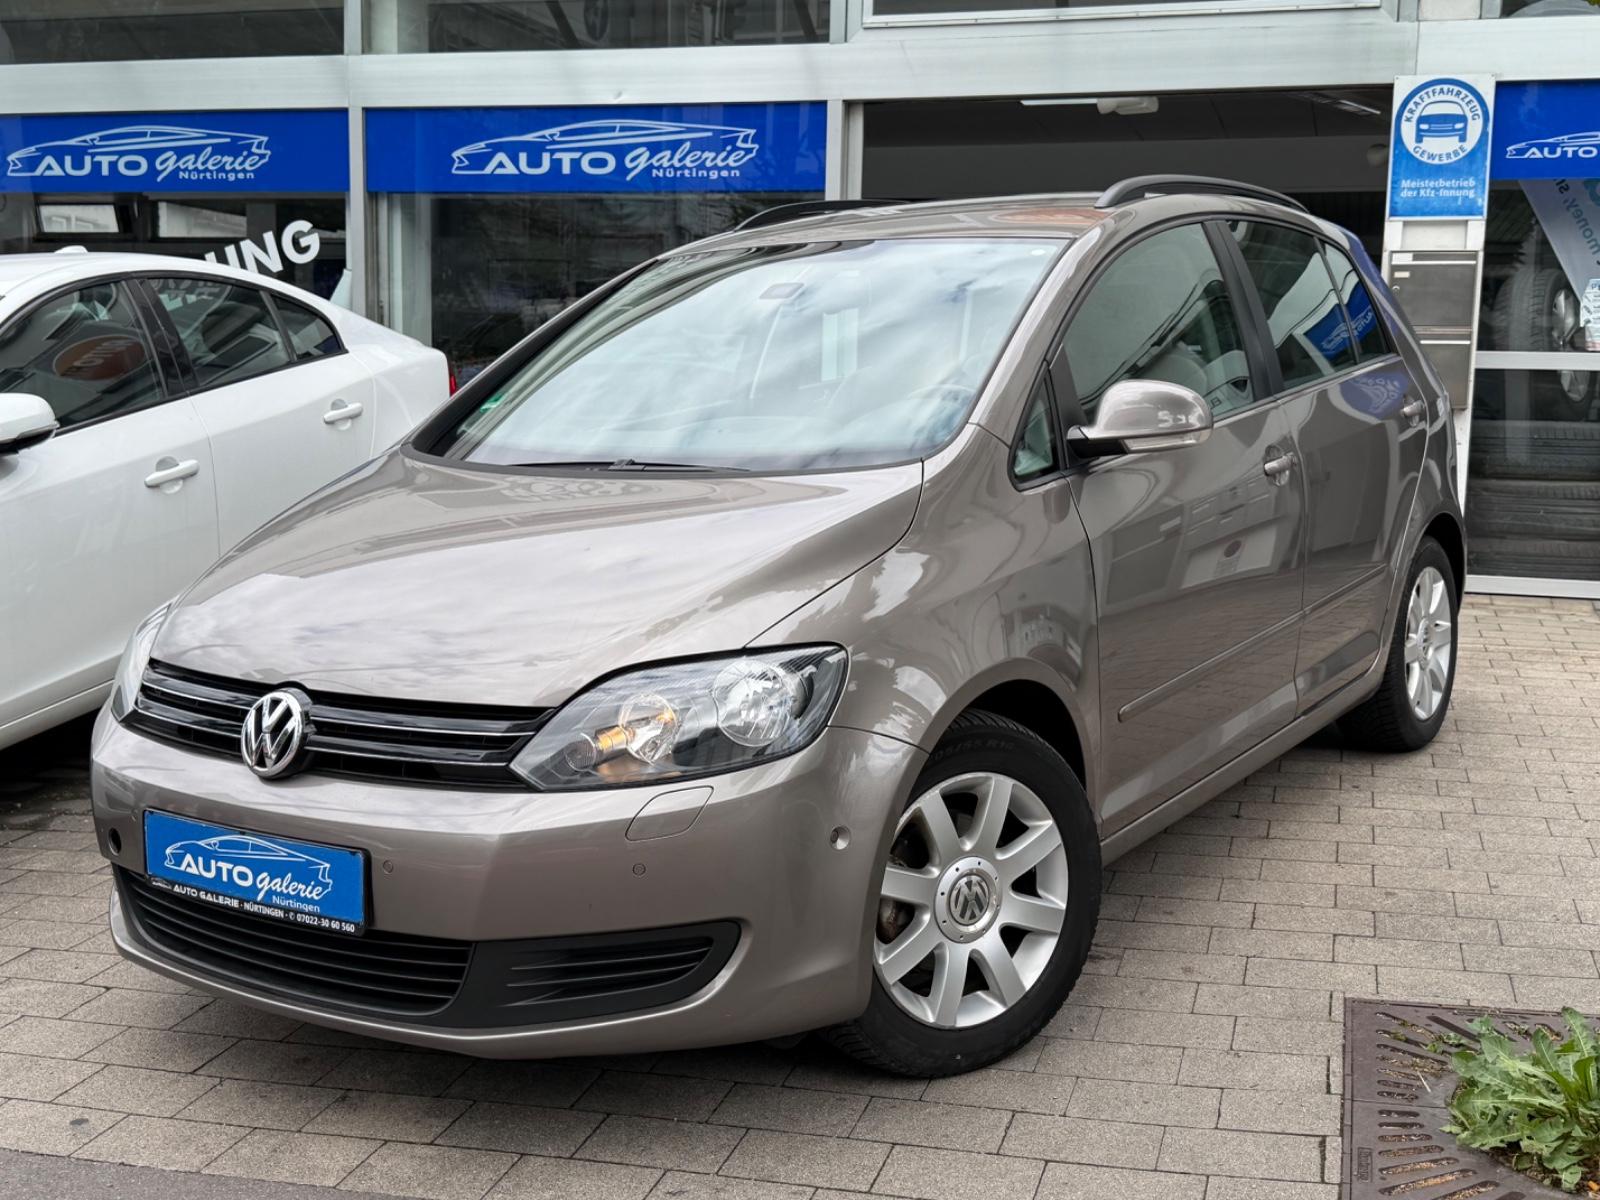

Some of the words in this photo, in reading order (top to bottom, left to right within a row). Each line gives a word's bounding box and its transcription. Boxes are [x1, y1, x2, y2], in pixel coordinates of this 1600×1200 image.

[1404, 87, 1480, 123] KRAFTFAHRZEUG
[483, 151, 616, 175] AUTO
[624, 141, 749, 181] galerie
[1413, 144, 1467, 162] GEWERBE
[1524, 146, 1598, 159] AUTO
[34, 154, 148, 176] AUTO
[155, 146, 263, 182] galerie
[651, 167, 740, 180] Nürtingen
[178, 169, 255, 182] Nürtingen
[1401, 176, 1476, 189] Meisterbetrieb
[1400, 187, 1417, 198] der
[1418, 187, 1475, 199] Kfz-Innung
[179, 853, 254, 887] AUTO
[256, 872, 324, 902] galerie
[173, 884, 198, 897] AUTO
[199, 891, 240, 908] GALERIE
[243, 901, 284, 919] NÜRTINGEN
[330, 920, 340, 930] 60
[341, 922, 355, 933] 560
[272, 894, 320, 914] Nürtingen
